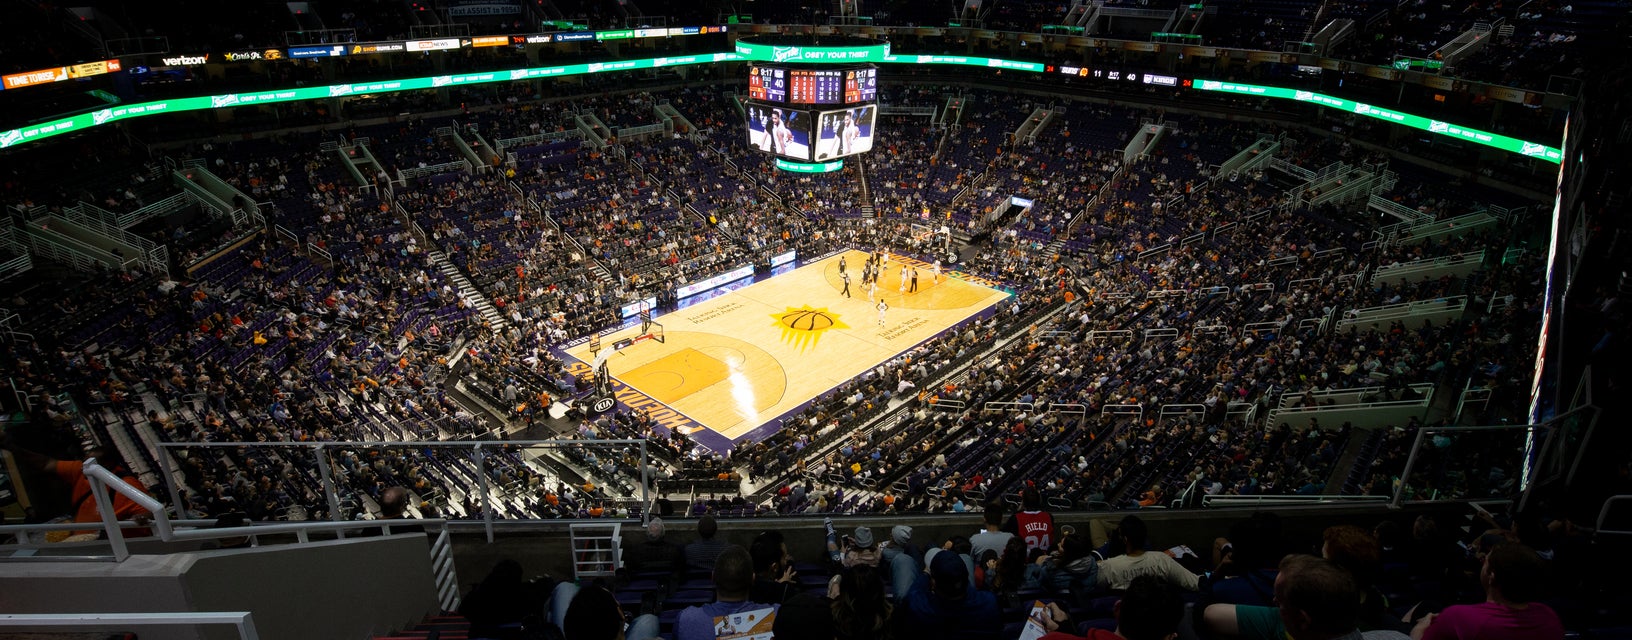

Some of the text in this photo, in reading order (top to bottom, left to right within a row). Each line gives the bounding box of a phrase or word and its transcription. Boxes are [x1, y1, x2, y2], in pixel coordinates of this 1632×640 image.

[527, 35, 550, 43] verizon
[232, 52, 250, 60] Carl's
[775, 46, 800, 61] Sprite
[162, 55, 206, 66] verizon
[760, 68, 773, 77] 9:17
[856, 70, 867, 79] 9:17
[1127, 73, 1136, 81] 40
[8, 74, 29, 86] TIME
[37, 71, 55, 83] RISE
[751, 76, 759, 85] 11
[867, 78, 876, 87] 40
[774, 79, 784, 88] 40
[848, 79, 855, 89] 11
[596, 400, 612, 411] KIA
[1024, 521, 1048, 533] HIELD
[1024, 533, 1051, 557] 24
[1122, 564, 1167, 580] DAYTONA
